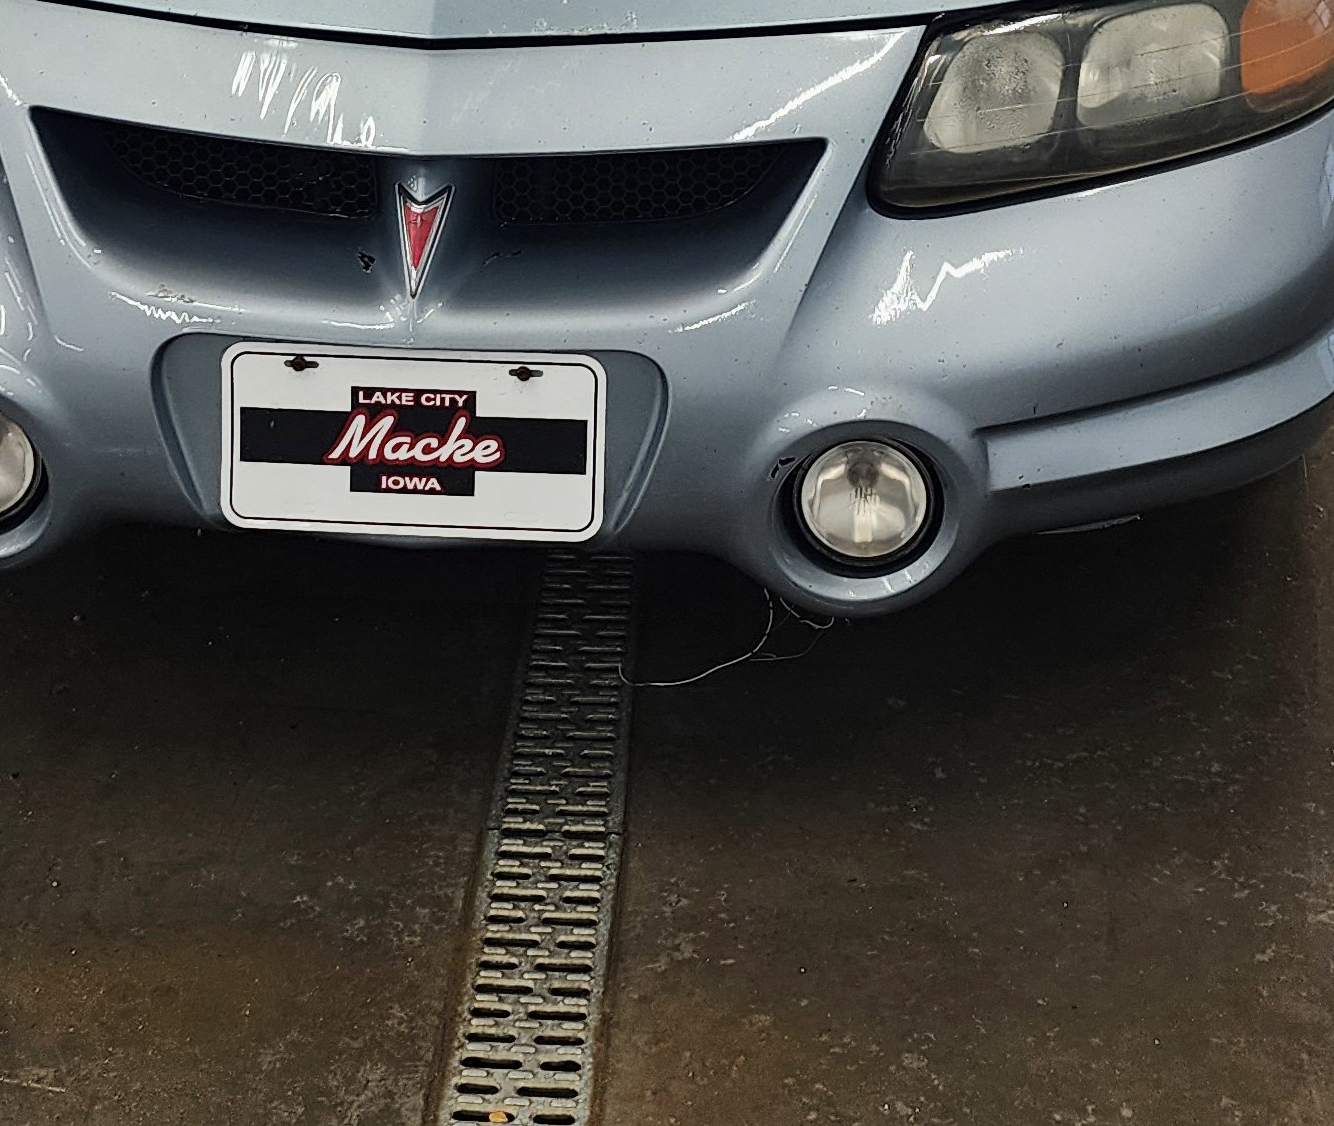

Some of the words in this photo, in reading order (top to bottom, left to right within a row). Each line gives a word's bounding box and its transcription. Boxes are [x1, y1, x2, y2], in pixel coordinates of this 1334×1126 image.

[358, 390, 415, 406] LAKE
[420, 393, 469, 407] CITY
[325, 412, 503, 466] Macke
[381, 475, 442, 491] IOWA
